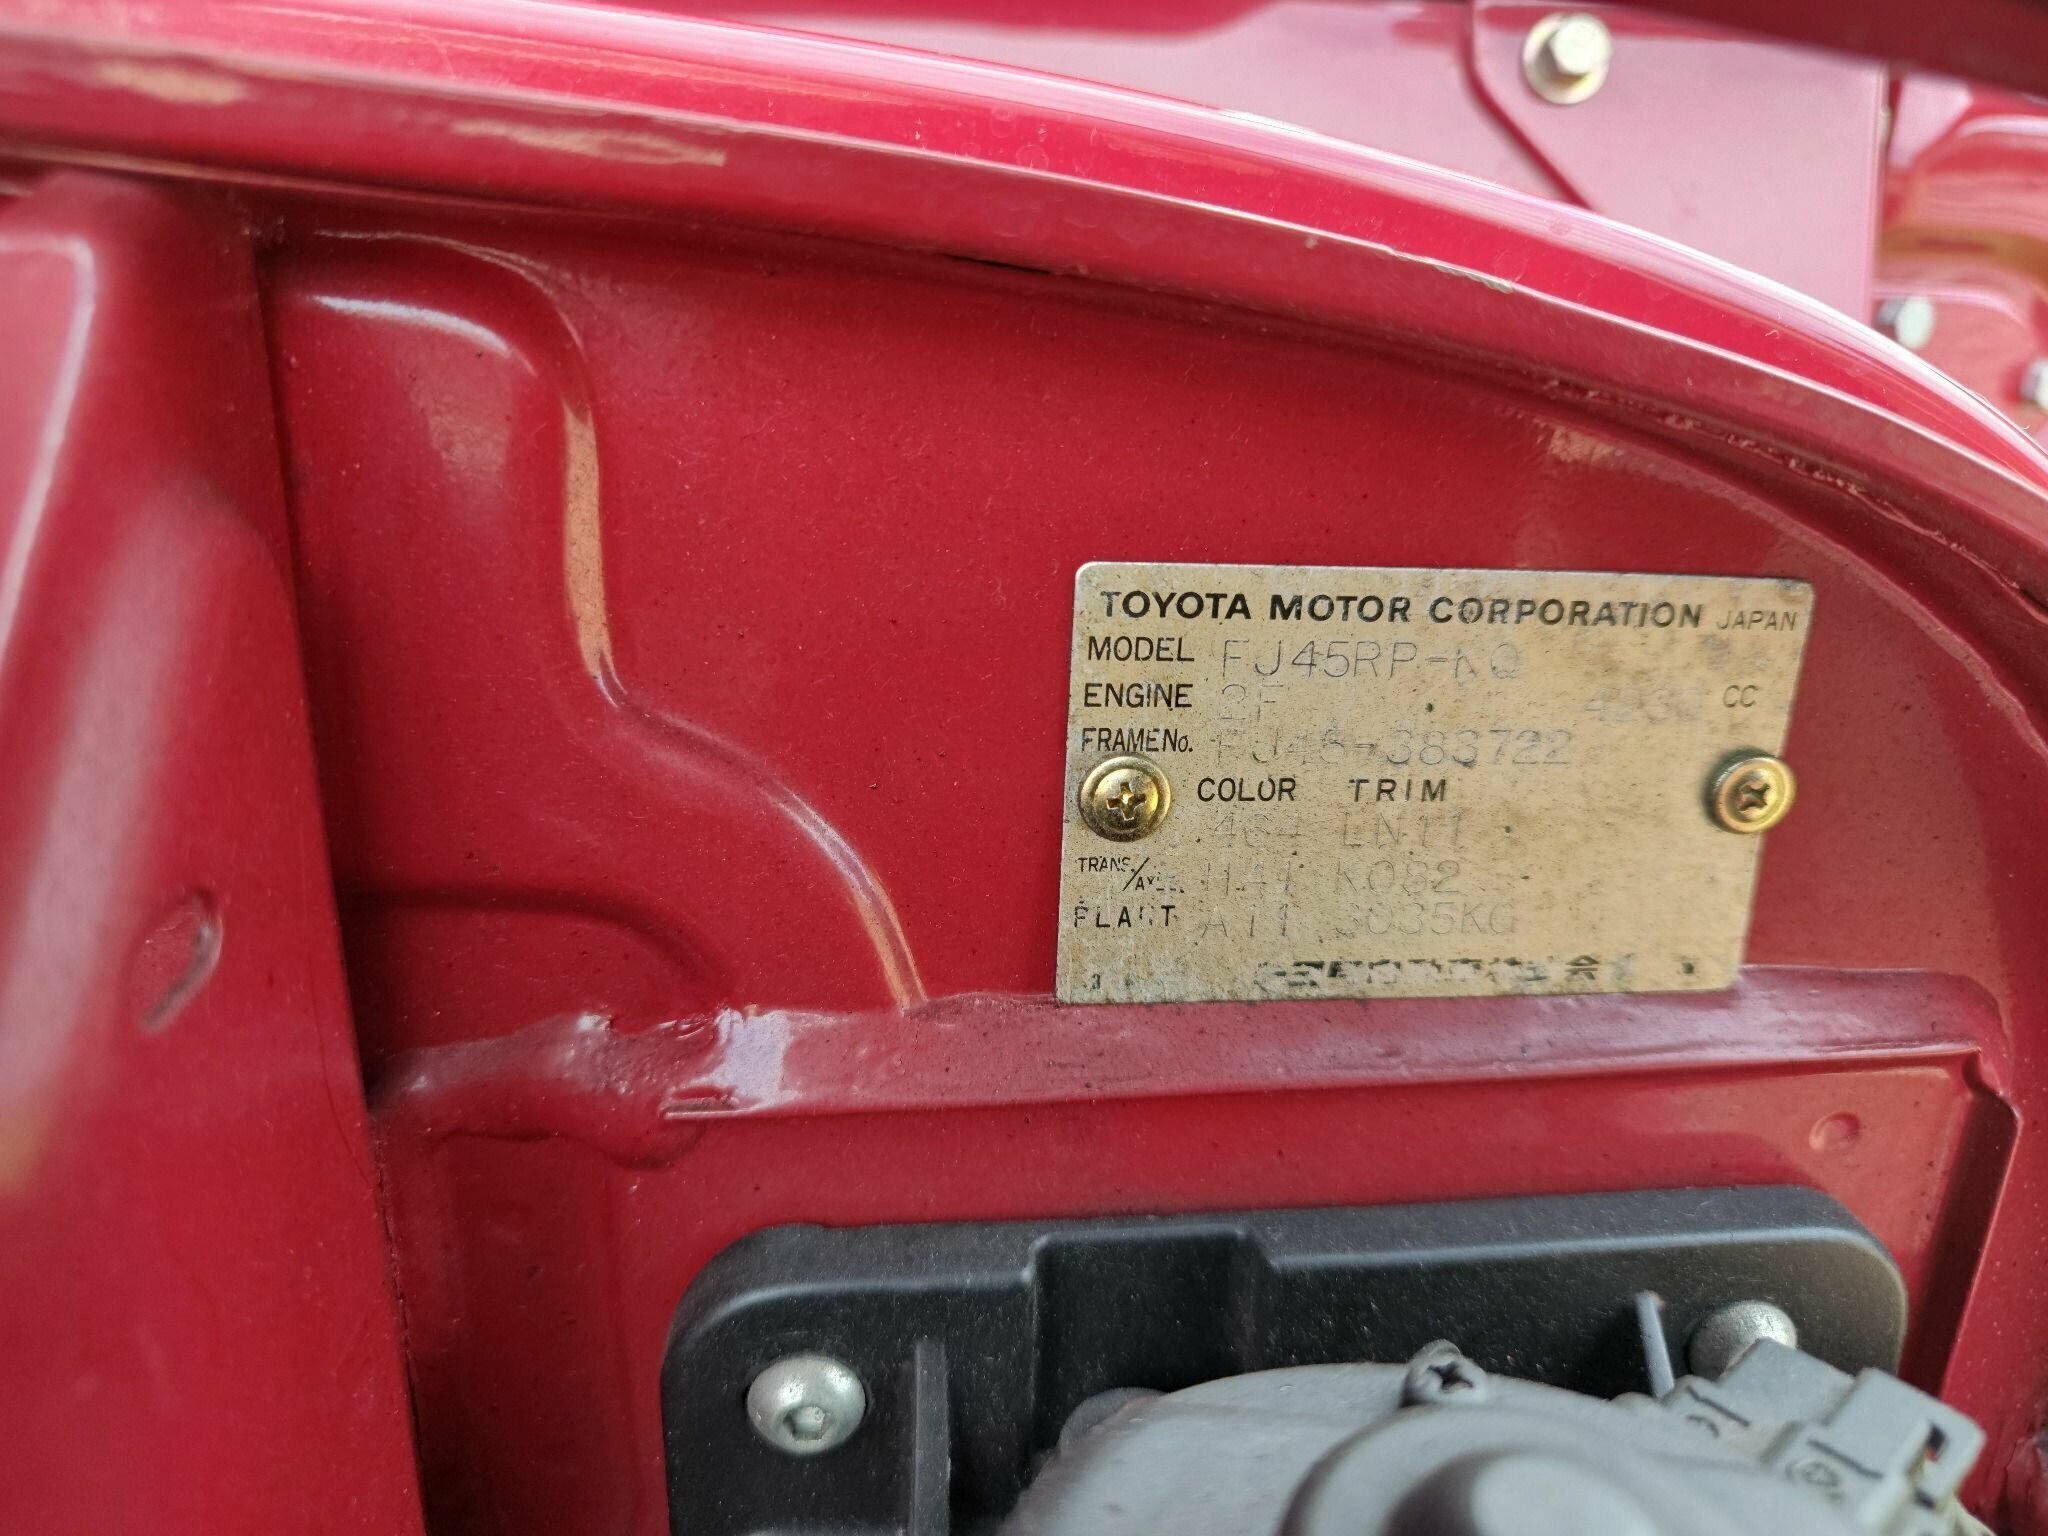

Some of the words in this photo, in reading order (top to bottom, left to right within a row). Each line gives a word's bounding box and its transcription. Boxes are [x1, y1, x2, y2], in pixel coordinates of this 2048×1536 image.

[1100, 590, 1251, 619] TOYOTA
[1270, 594, 1410, 623] MOTOR
[1428, 596, 1704, 629] CORPORATION
[1715, 609, 1798, 631] JAPAN
[1087, 636, 1195, 662] MODEL
[1083, 683, 1193, 708] ENGINE
[1723, 684, 1759, 708] CC
[1197, 777, 1297, 802] COLOR
[1349, 778, 1447, 802] TRIM
